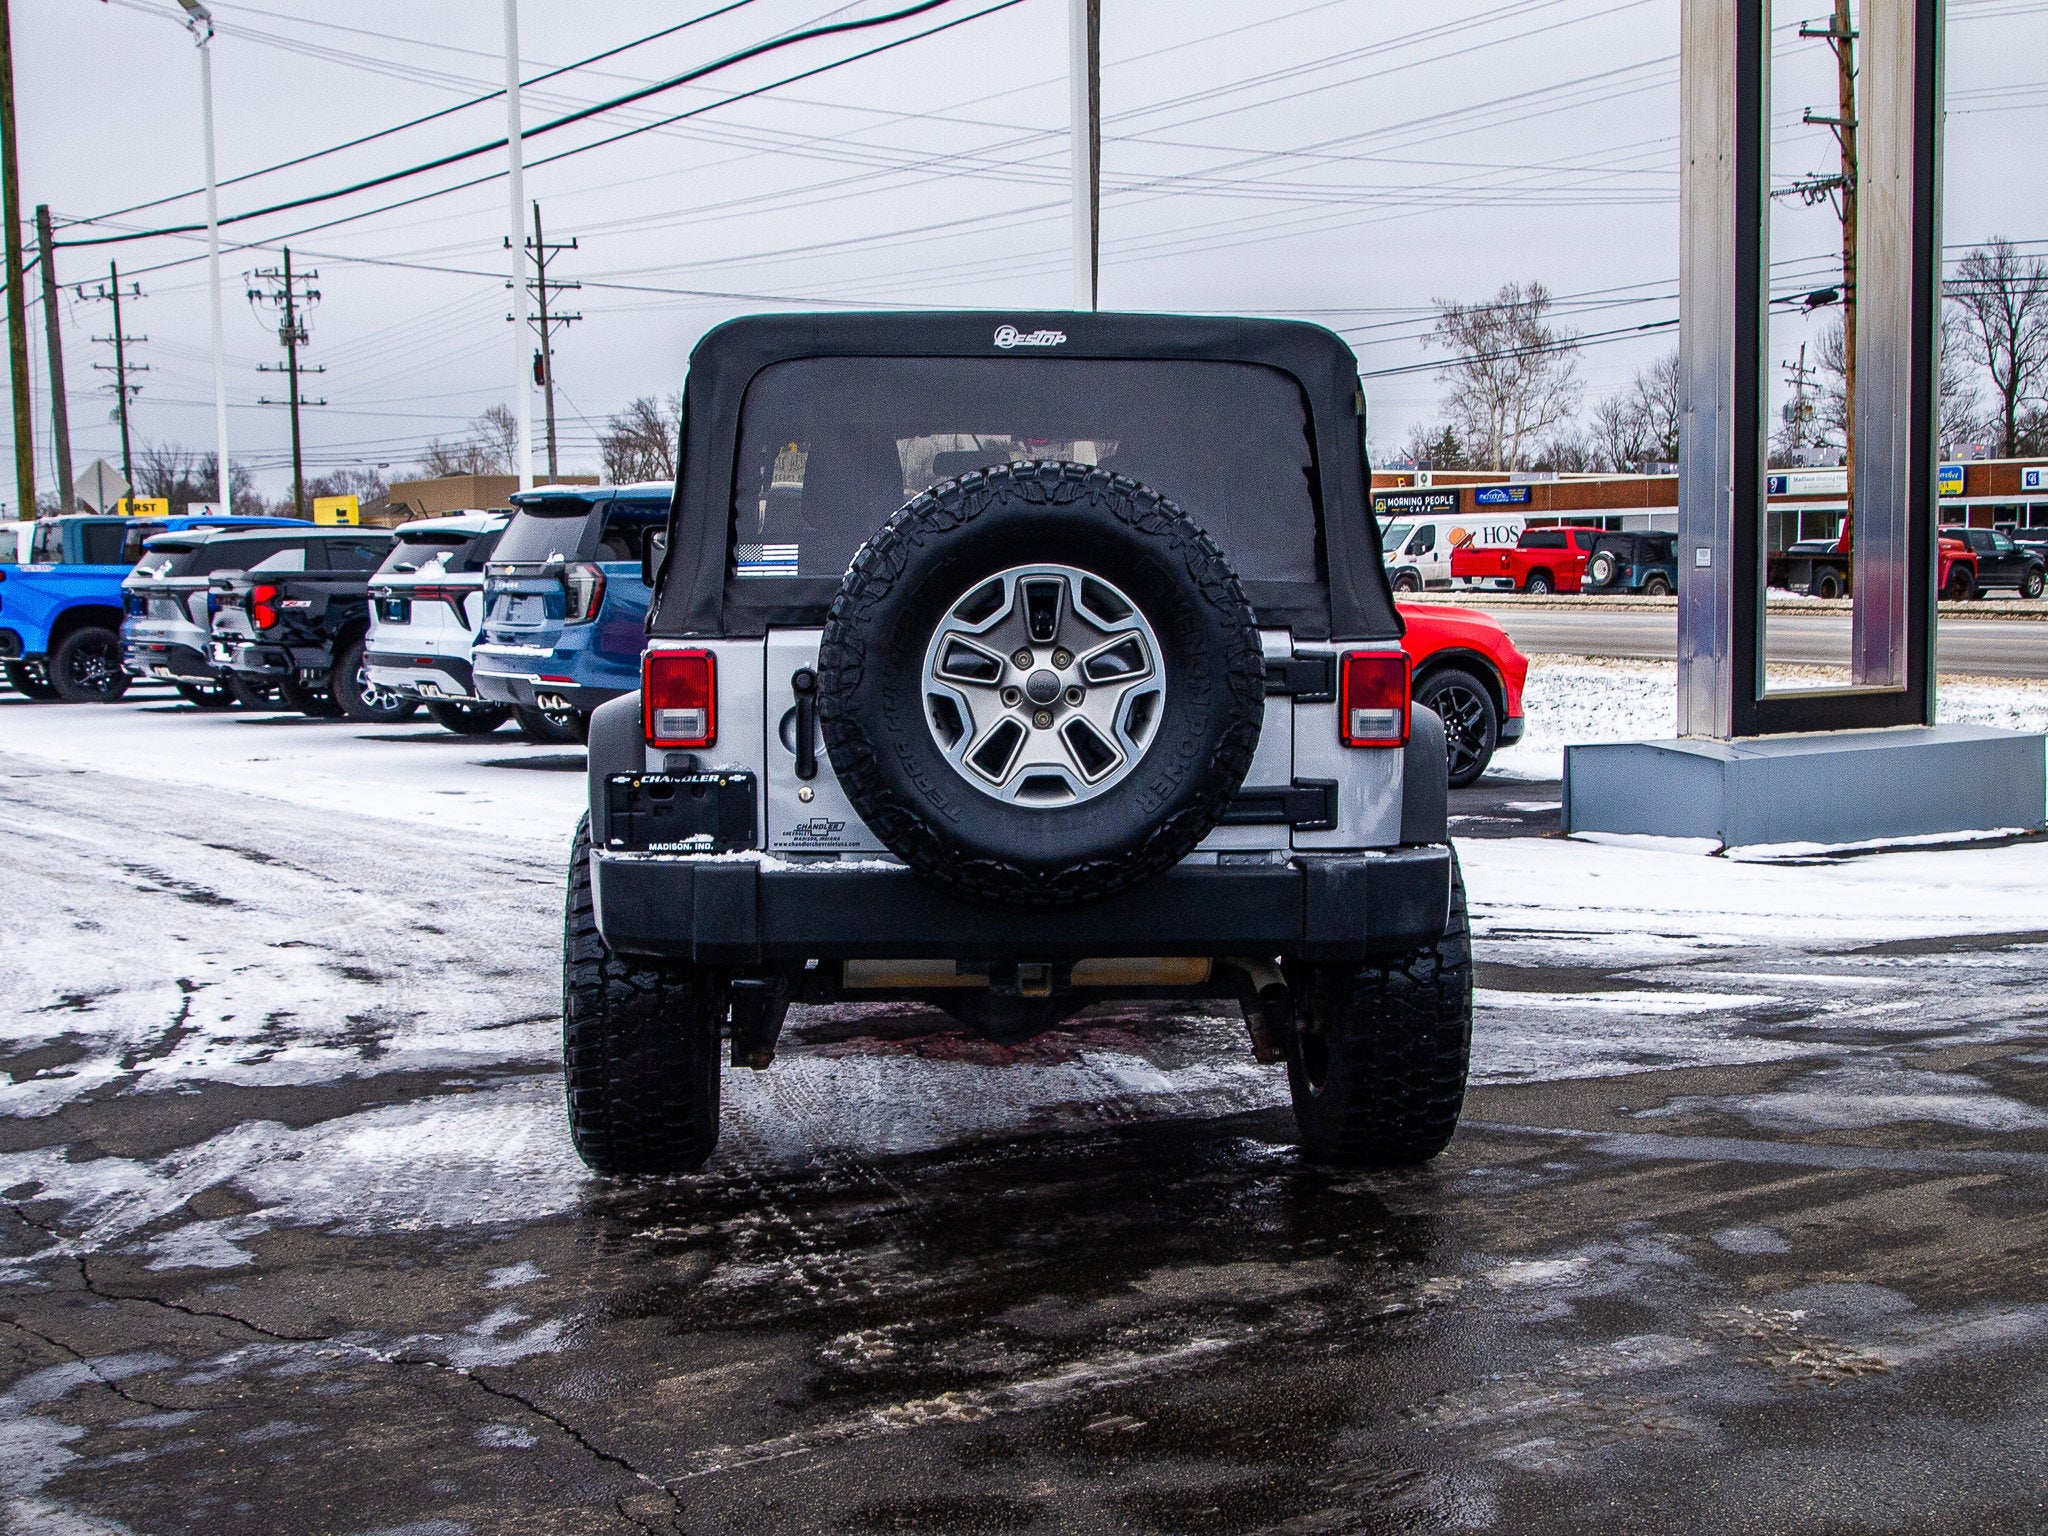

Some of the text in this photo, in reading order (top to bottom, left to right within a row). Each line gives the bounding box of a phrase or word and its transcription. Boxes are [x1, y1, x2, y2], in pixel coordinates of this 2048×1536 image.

[1387, 495, 1454, 507] MORNING PEOPLE
[1482, 525, 1519, 543] HOS
[796, 823, 840, 831] CHANDLER
[649, 842, 714, 851] MADISON, IND.
